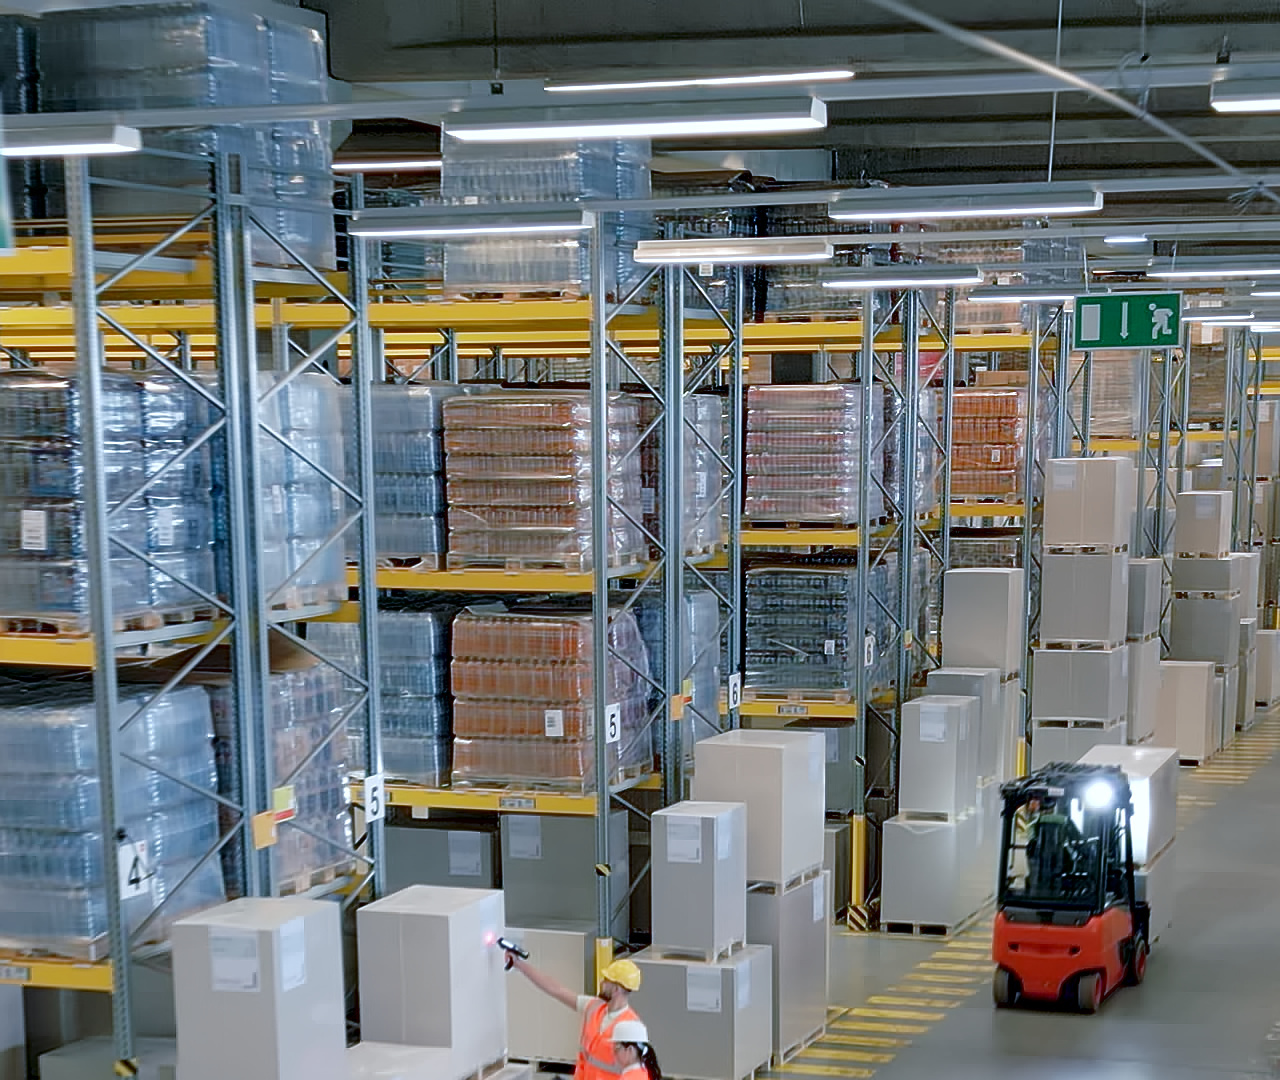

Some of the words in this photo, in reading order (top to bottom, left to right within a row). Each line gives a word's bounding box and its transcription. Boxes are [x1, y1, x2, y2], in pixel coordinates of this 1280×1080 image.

[732, 682, 738, 706] 6
[609, 713, 617, 738] 5
[371, 786, 379, 816] 5
[127, 855, 141, 889] 4
